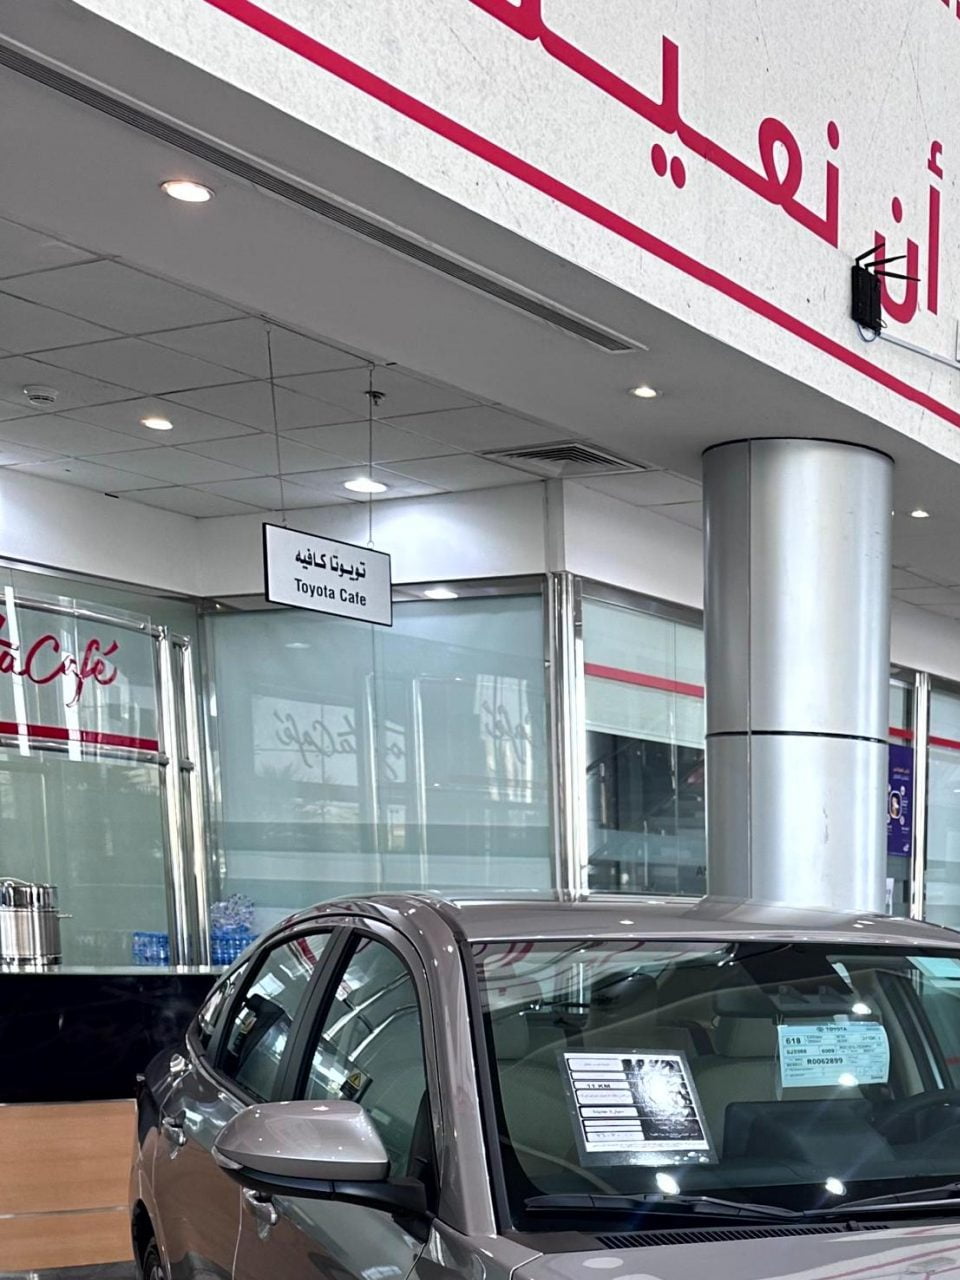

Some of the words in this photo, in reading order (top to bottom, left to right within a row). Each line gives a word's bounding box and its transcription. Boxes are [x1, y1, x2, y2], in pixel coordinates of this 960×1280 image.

[468, 0, 839, 248] نعي
[295, 548, 327, 570] كافيه
[330, 554, 366, 582] تويوتا
[294, 577, 336, 600] Toyota
[340, 588, 367, 607] Cafe
